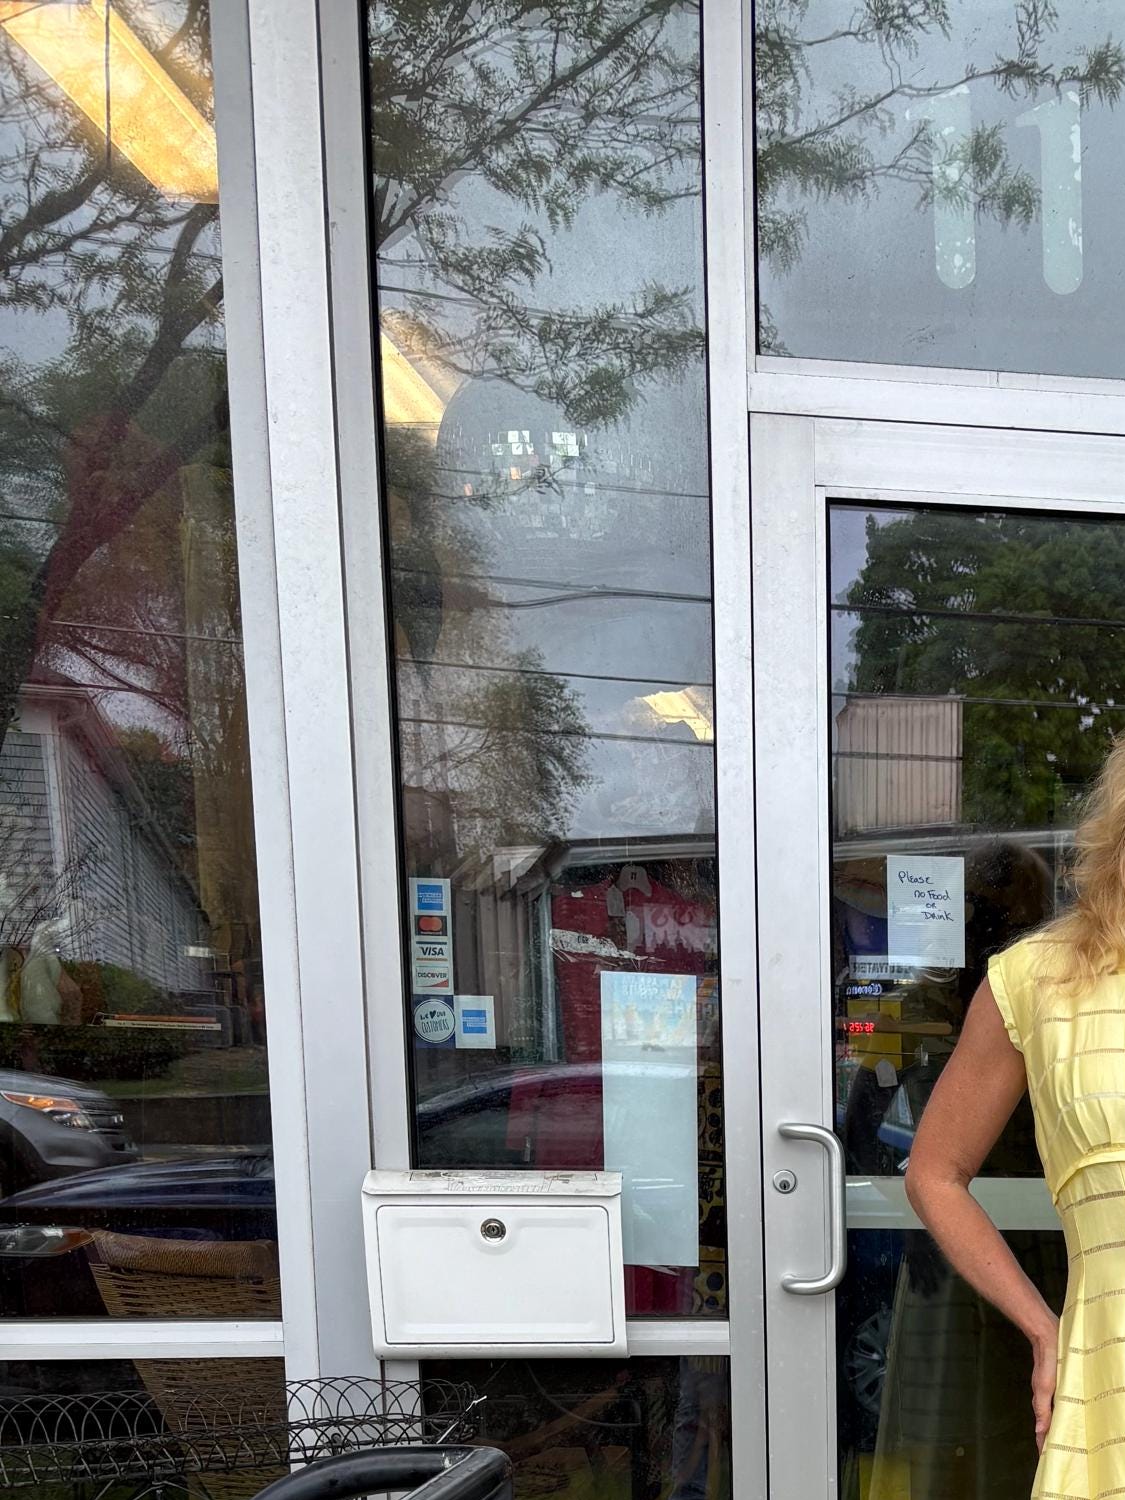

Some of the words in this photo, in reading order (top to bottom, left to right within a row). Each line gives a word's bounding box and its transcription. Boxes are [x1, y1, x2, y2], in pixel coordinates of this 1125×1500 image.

[898, 870, 934, 884] Please
[914, 889, 925, 898] no
[927, 889, 951, 900] Food
[419, 947, 445, 956] VISA
